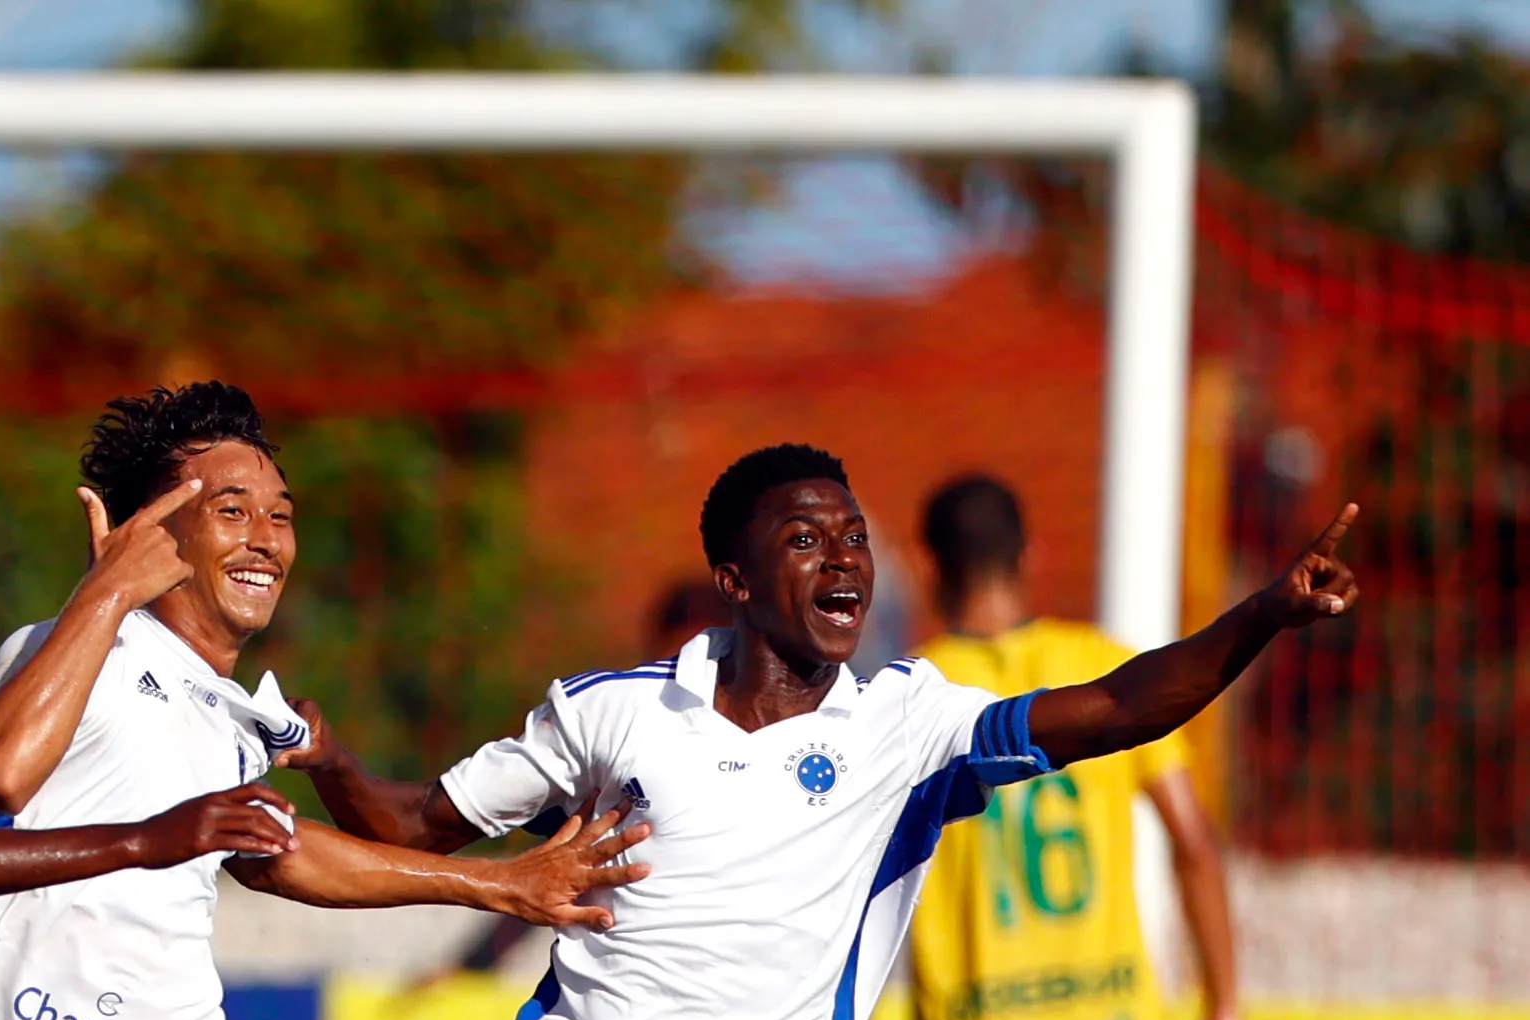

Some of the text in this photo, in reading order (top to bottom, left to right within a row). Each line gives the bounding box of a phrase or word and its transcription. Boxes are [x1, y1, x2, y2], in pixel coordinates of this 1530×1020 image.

[718, 760, 751, 772] CIM
[784, 742, 848, 773] CRUZEIRO
[982, 770, 1093, 920] 16
